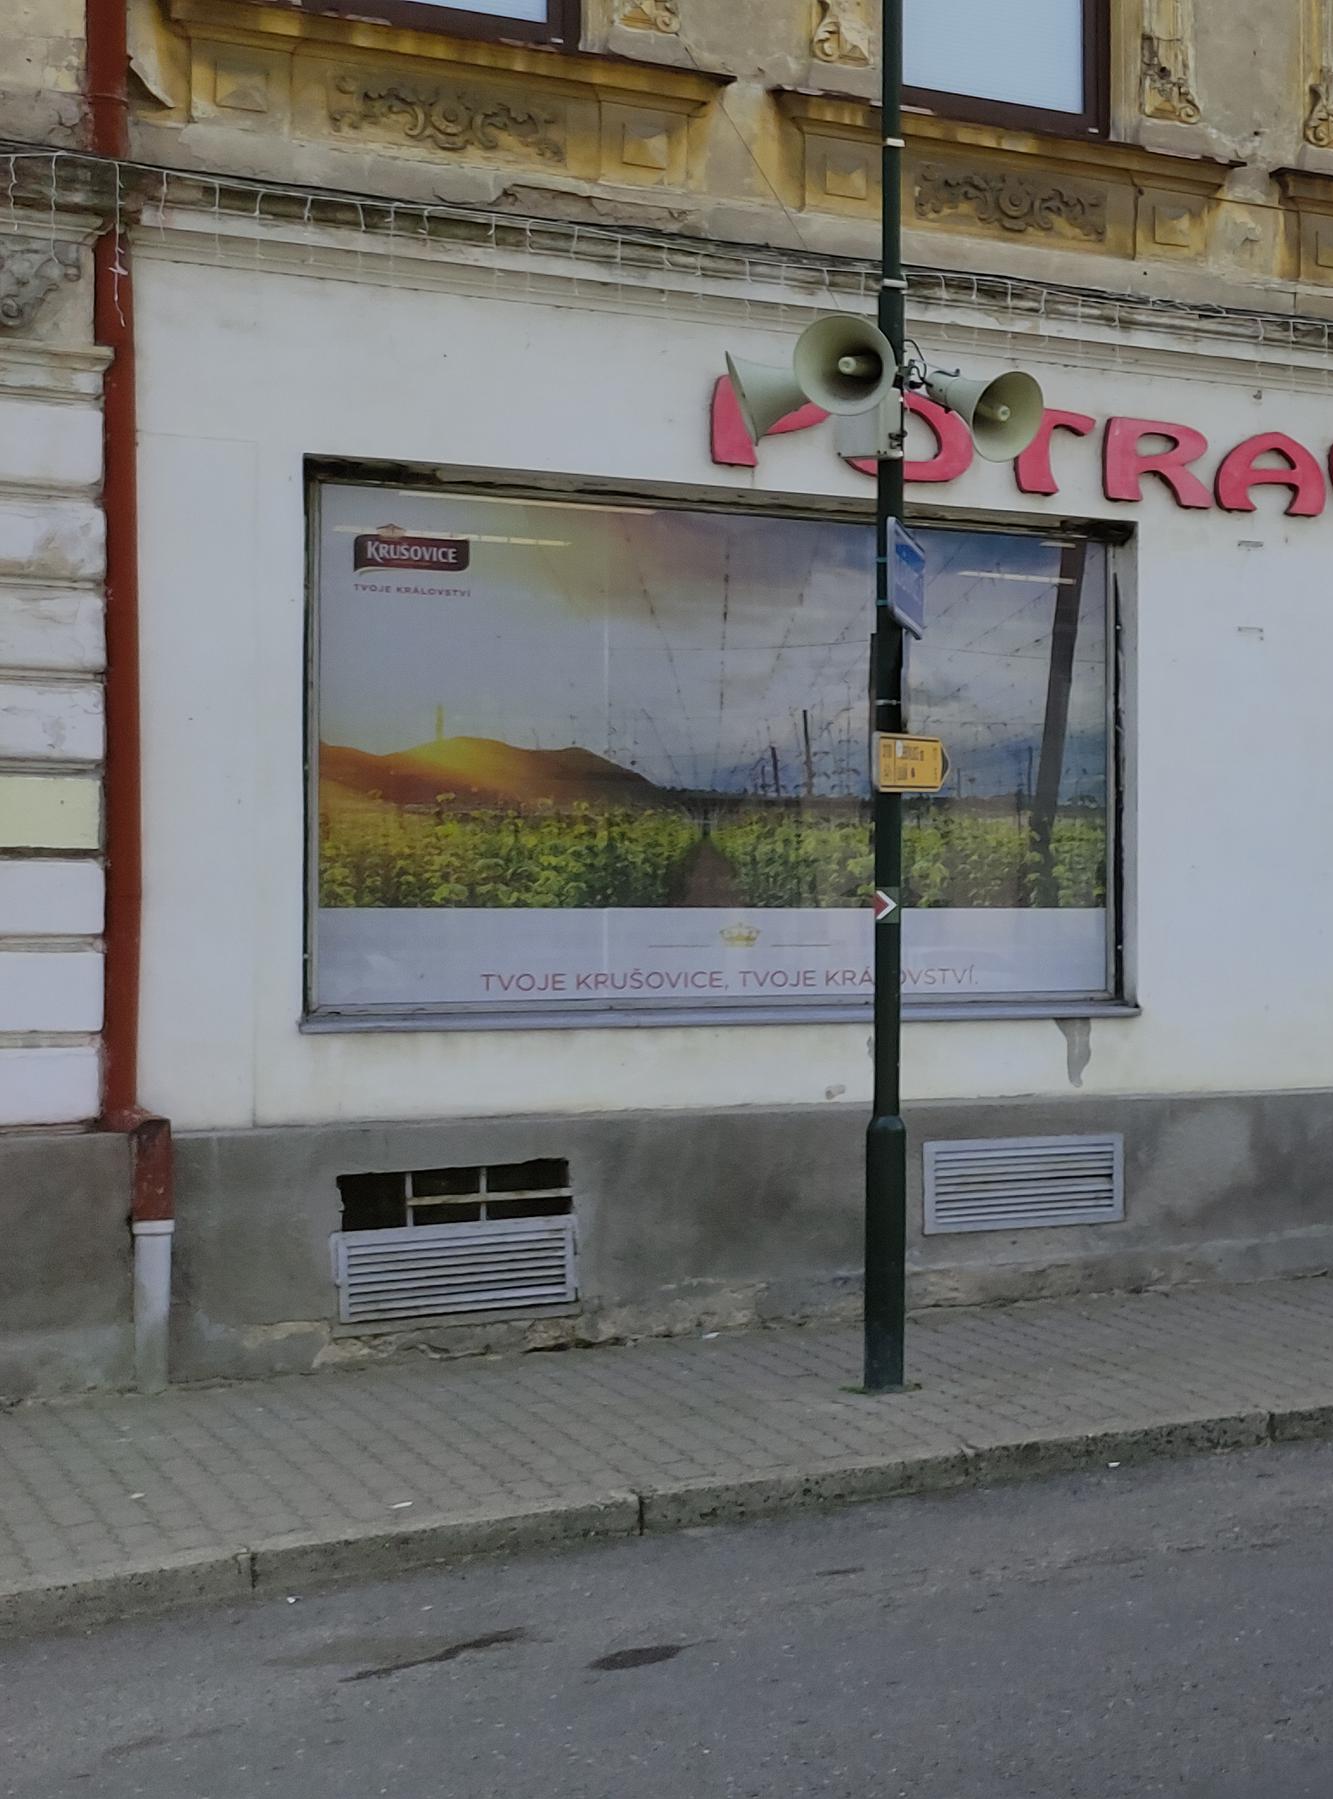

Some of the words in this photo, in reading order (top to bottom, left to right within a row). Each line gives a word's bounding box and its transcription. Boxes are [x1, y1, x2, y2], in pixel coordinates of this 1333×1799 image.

[366, 540, 458, 564] KRUŠOVICE
[353, 583, 392, 594] TVOJE
[480, 973, 567, 992] TVOJE
[576, 967, 729, 990] KRUŠOVICE,
[738, 970, 816, 988] TVOJE
